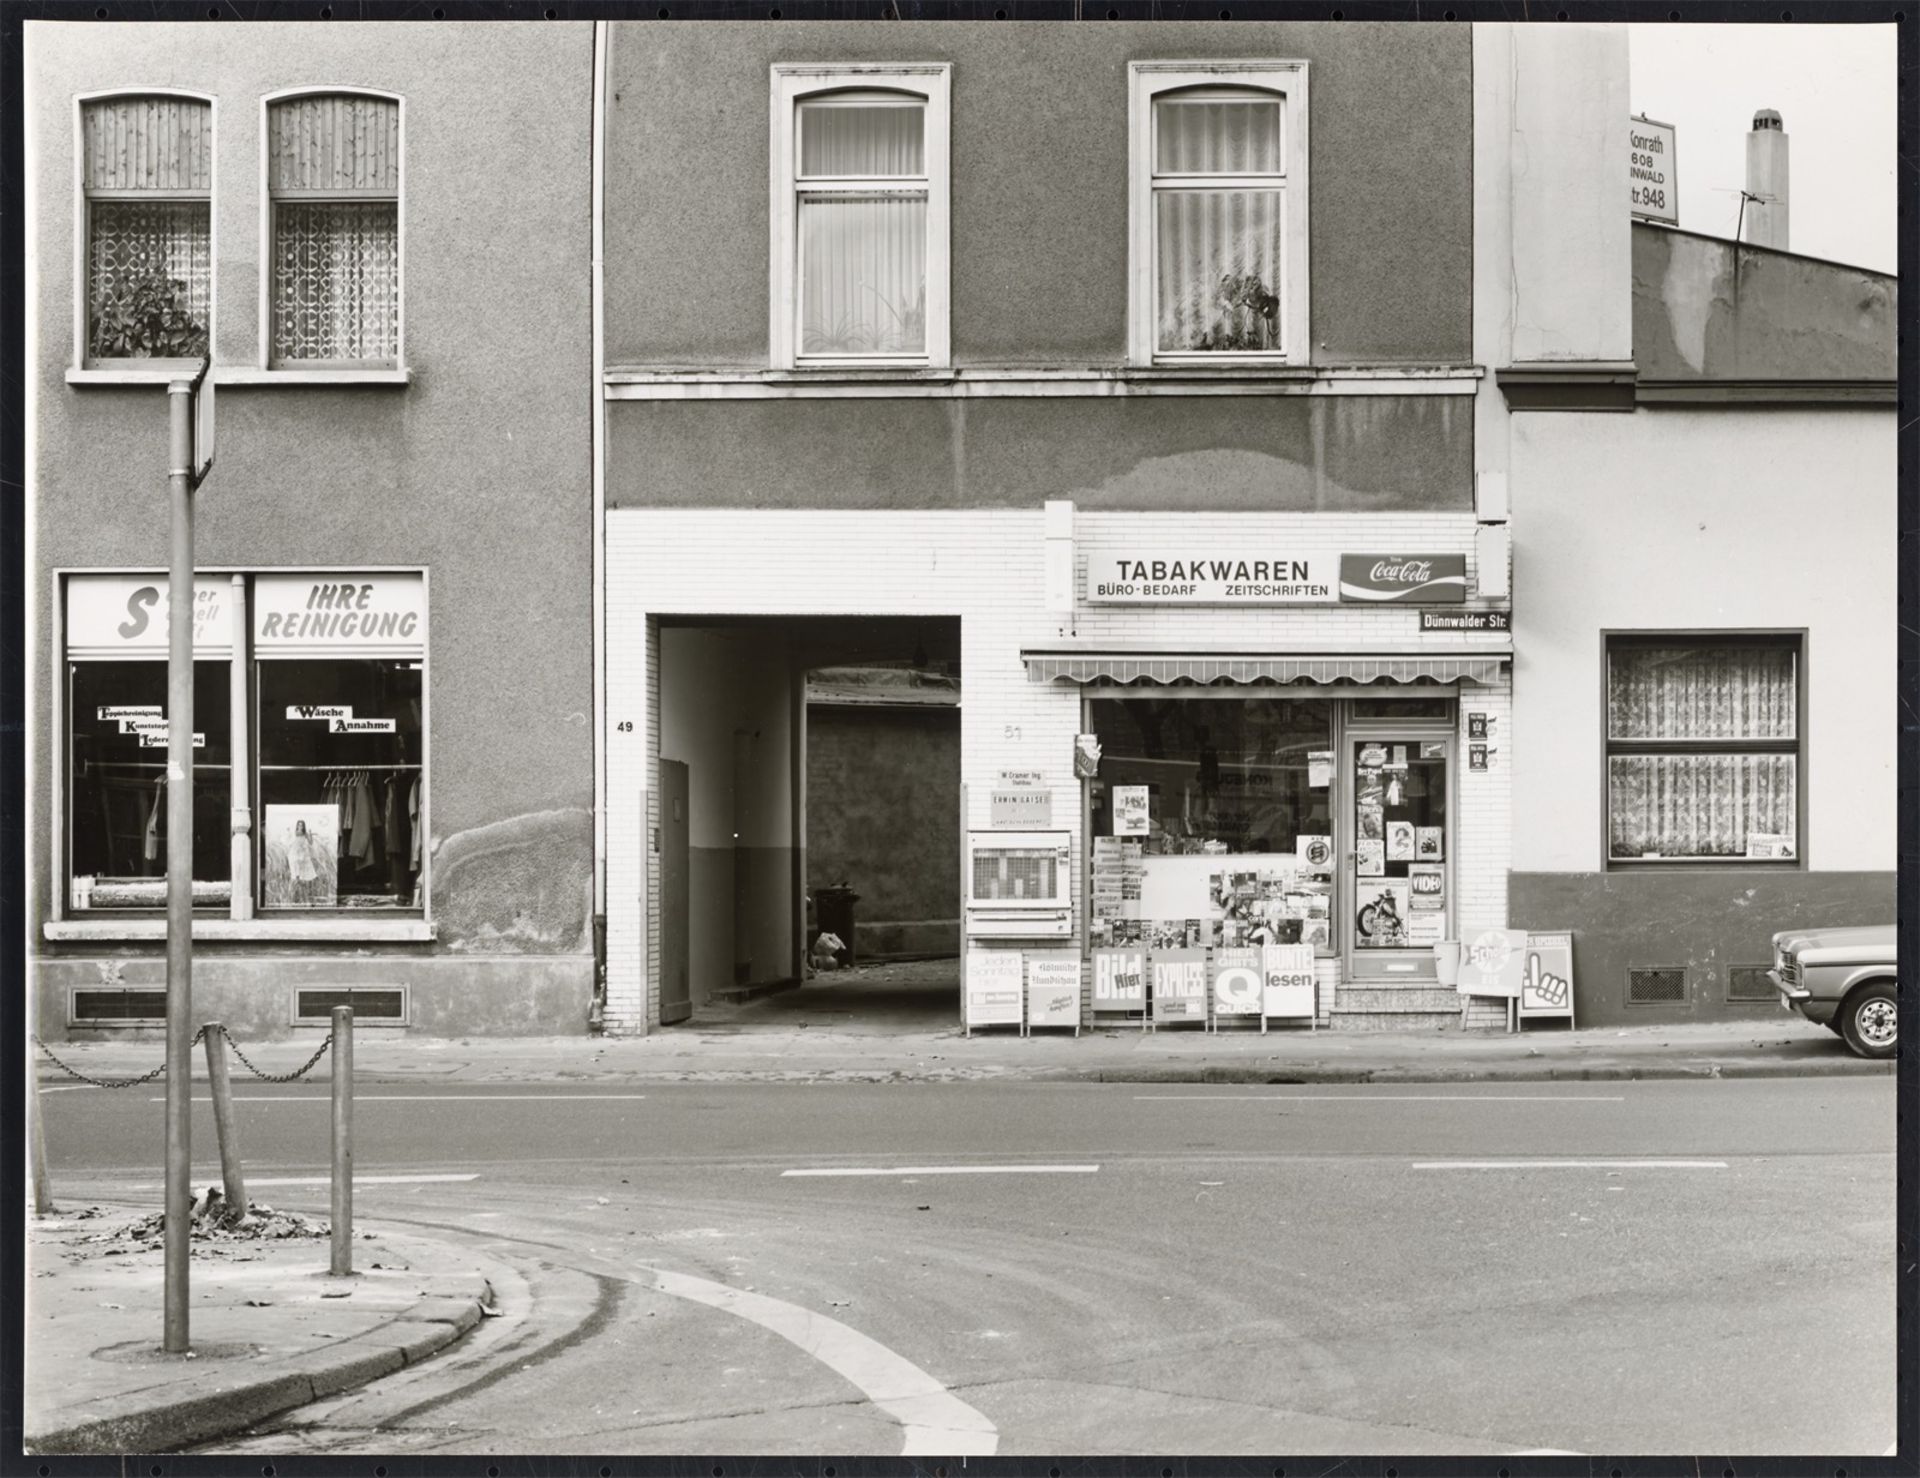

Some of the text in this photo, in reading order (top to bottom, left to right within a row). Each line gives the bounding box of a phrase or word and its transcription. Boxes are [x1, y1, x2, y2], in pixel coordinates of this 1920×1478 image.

[1116, 560, 1309, 581] TABAKWAREN
[1369, 561, 1433, 582] Coca-Cola
[306, 583, 374, 611] IHRE
[1225, 584, 1329, 596] ZEITSCHRIFTEN
[261, 611, 418, 639] REINIGUNG
[1424, 614, 1507, 628] Dünnwalder Str.
[294, 705, 344, 719] Wäsche
[334, 719, 390, 733] Annahme
[616, 721, 634, 733] 49
[1412, 873, 1441, 892] VIDEO
[1265, 948, 1312, 970] BUNTE
[1096, 953, 1142, 1000] Bild
[1114, 972, 1141, 990] Hier
[1155, 962, 1204, 998] EXPRESS
[1215, 967, 1261, 1006] Q
[1265, 971, 1312, 987] lesen
